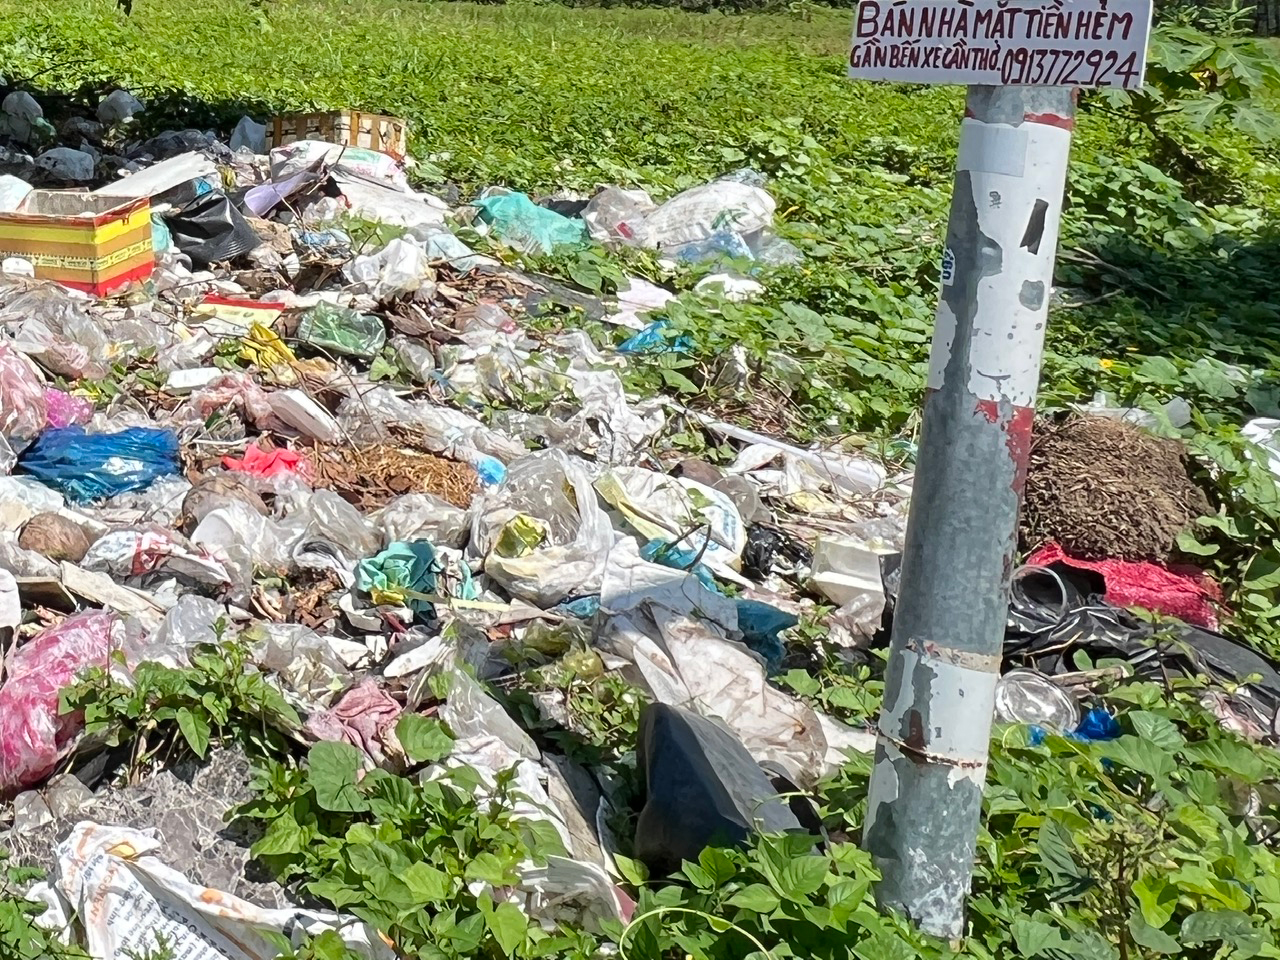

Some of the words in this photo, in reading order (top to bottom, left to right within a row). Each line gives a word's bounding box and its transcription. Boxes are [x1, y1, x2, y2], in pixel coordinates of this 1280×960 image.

[856, 0, 915, 38] BÁN
[918, 0, 974, 38] NHÀ
[1023, 0, 1073, 39] TIỀN
[1075, 0, 1133, 40] HẺM
[850, 37, 887, 68] GẦN
[889, 39, 921, 69] BẾN
[921, 46, 942, 68] XE
[942, 38, 970, 70] CẦN
[1001, 47, 1139, 88] 0913772924
